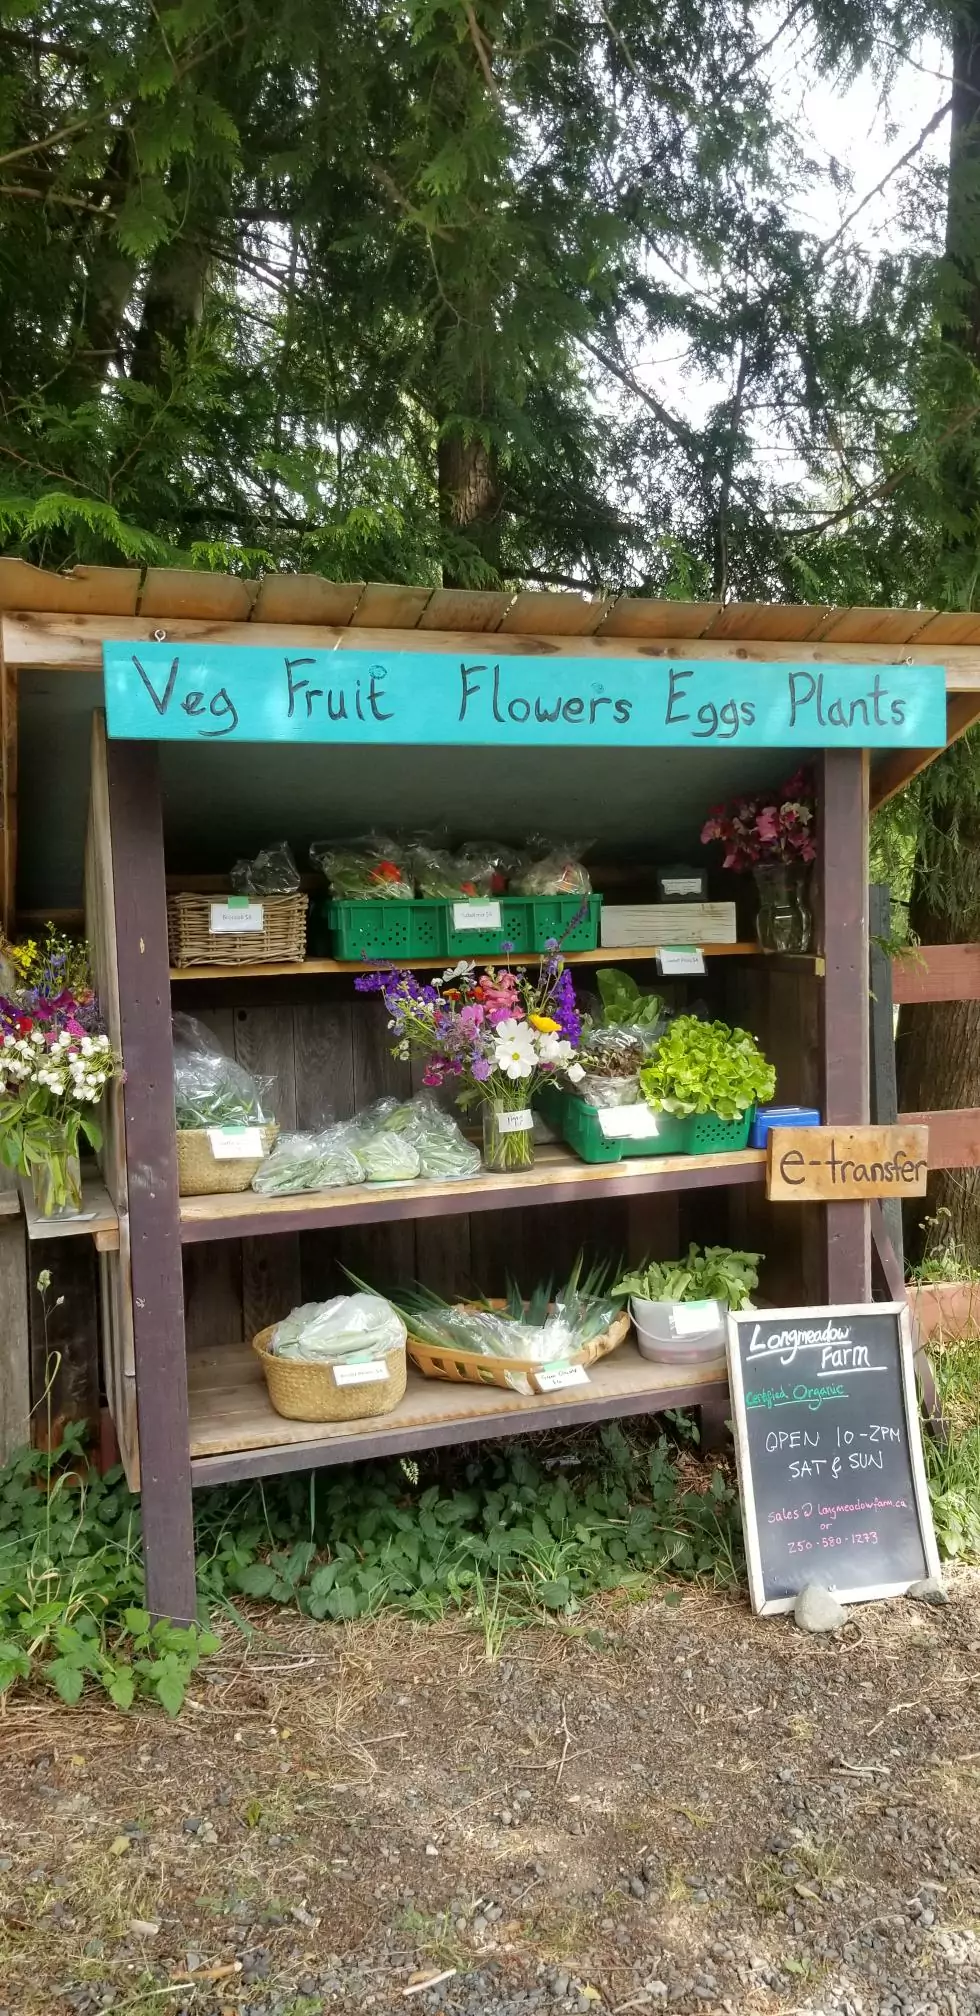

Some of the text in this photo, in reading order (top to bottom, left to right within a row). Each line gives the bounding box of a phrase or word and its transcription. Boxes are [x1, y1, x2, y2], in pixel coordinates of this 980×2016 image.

[131, 655, 907, 739] Veg Fruit Flowers Eggs Plants
[779, 1138, 928, 1185] e-transfer
[748, 1319, 851, 1365] Longmeadow
[820, 1344, 871, 1370] Farm
[792, 1383, 845, 1411] Organic
[765, 1430, 820, 1453] OPEN
[788, 1459, 828, 1479] SAT
[848, 1450, 884, 1470] SUN
[819, 1521, 832, 1532] or
